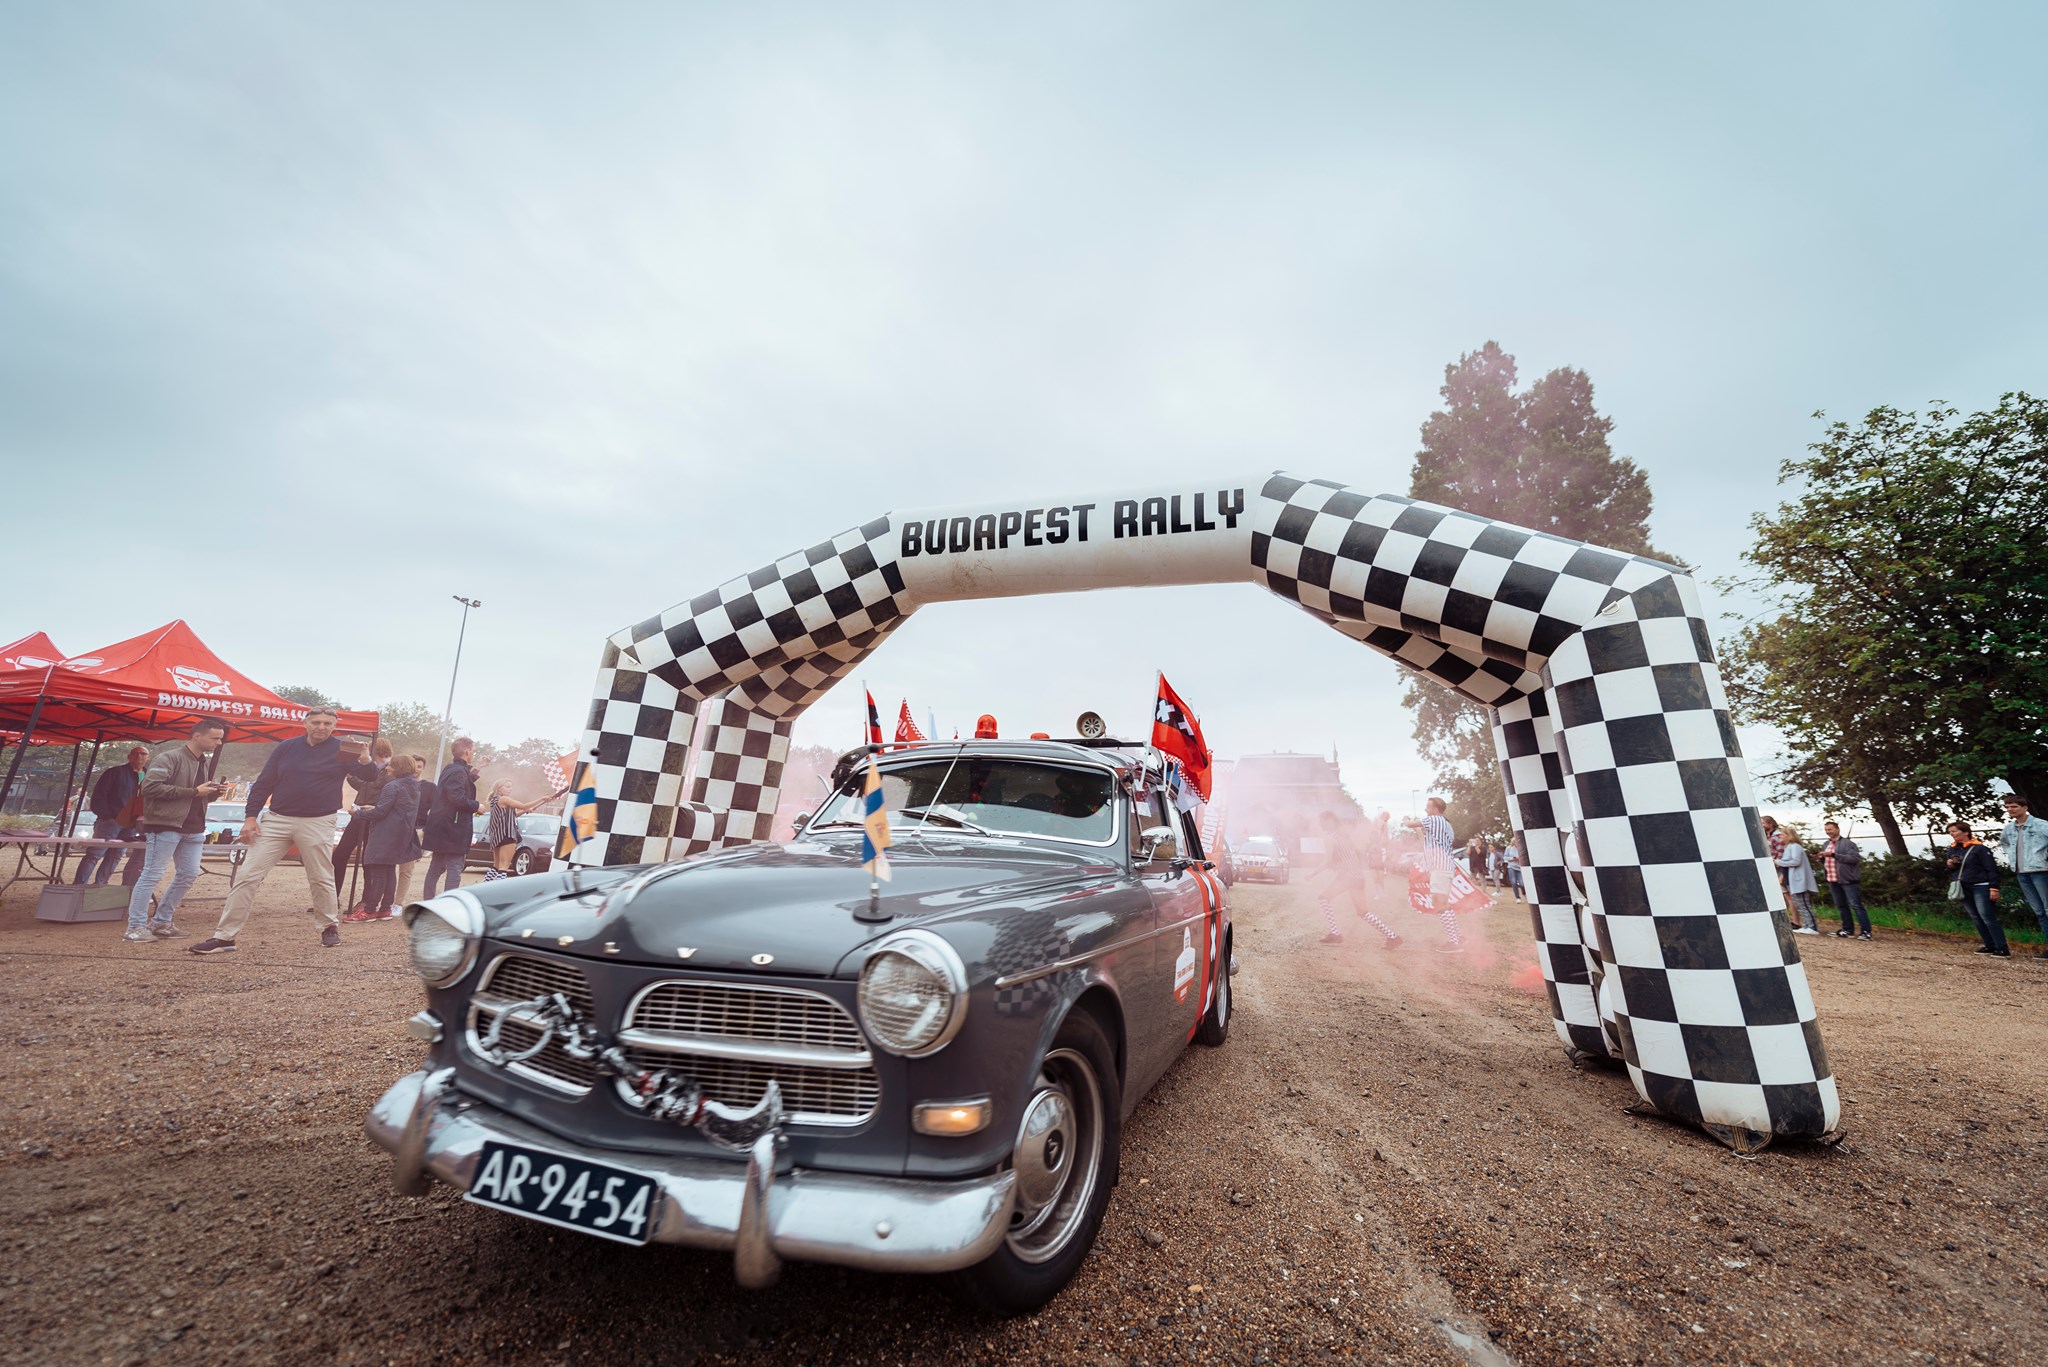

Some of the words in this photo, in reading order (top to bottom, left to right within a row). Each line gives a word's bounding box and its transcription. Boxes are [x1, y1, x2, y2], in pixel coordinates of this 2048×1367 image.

[901, 503, 1096, 558] BUDAPEST
[1113, 488, 1245, 539] RALLY
[157, 692, 254, 716] BUDAPEST
[471, 1150, 650, 1236] AR-94-54
